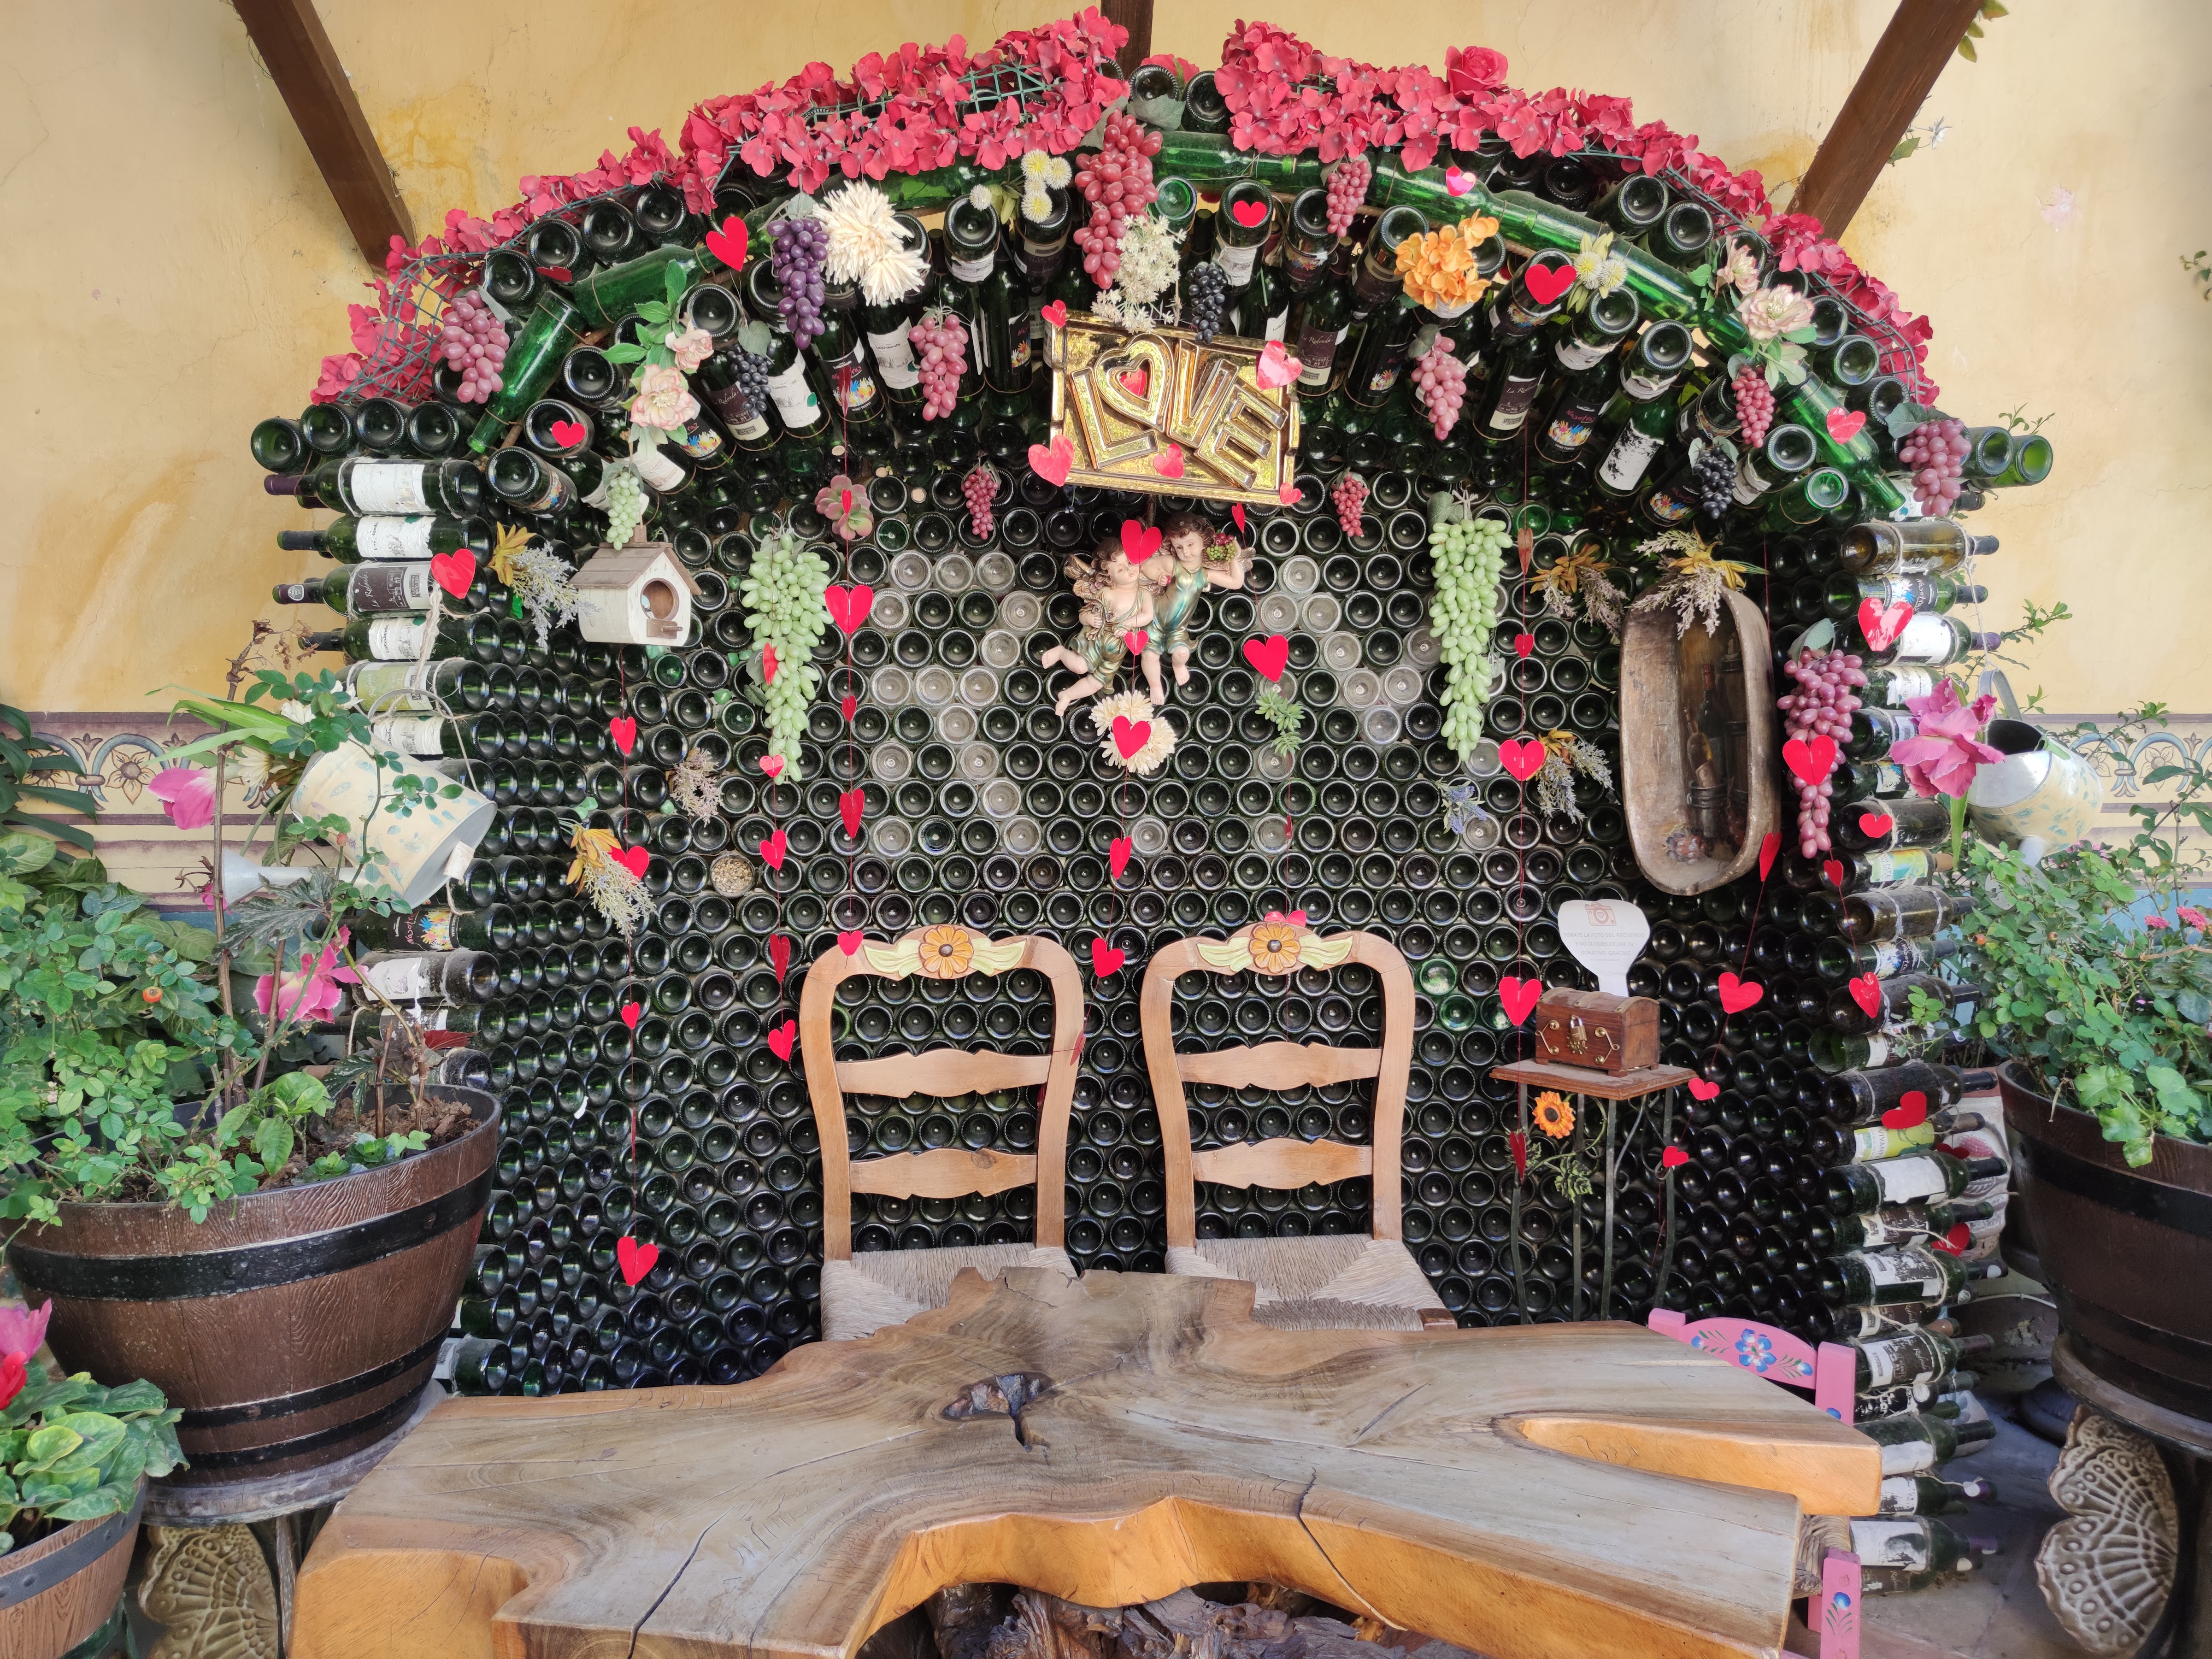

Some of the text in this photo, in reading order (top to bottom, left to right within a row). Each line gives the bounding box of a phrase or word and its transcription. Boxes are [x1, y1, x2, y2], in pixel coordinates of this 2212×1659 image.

[1309, 335, 1332, 345] Redonda
[718, 388, 737, 405] Redonda
[1068, 333, 1289, 491] LOVE
[358, 574, 374, 598] Redonda
[1874, 1129, 1885, 1159] VIVANTE
